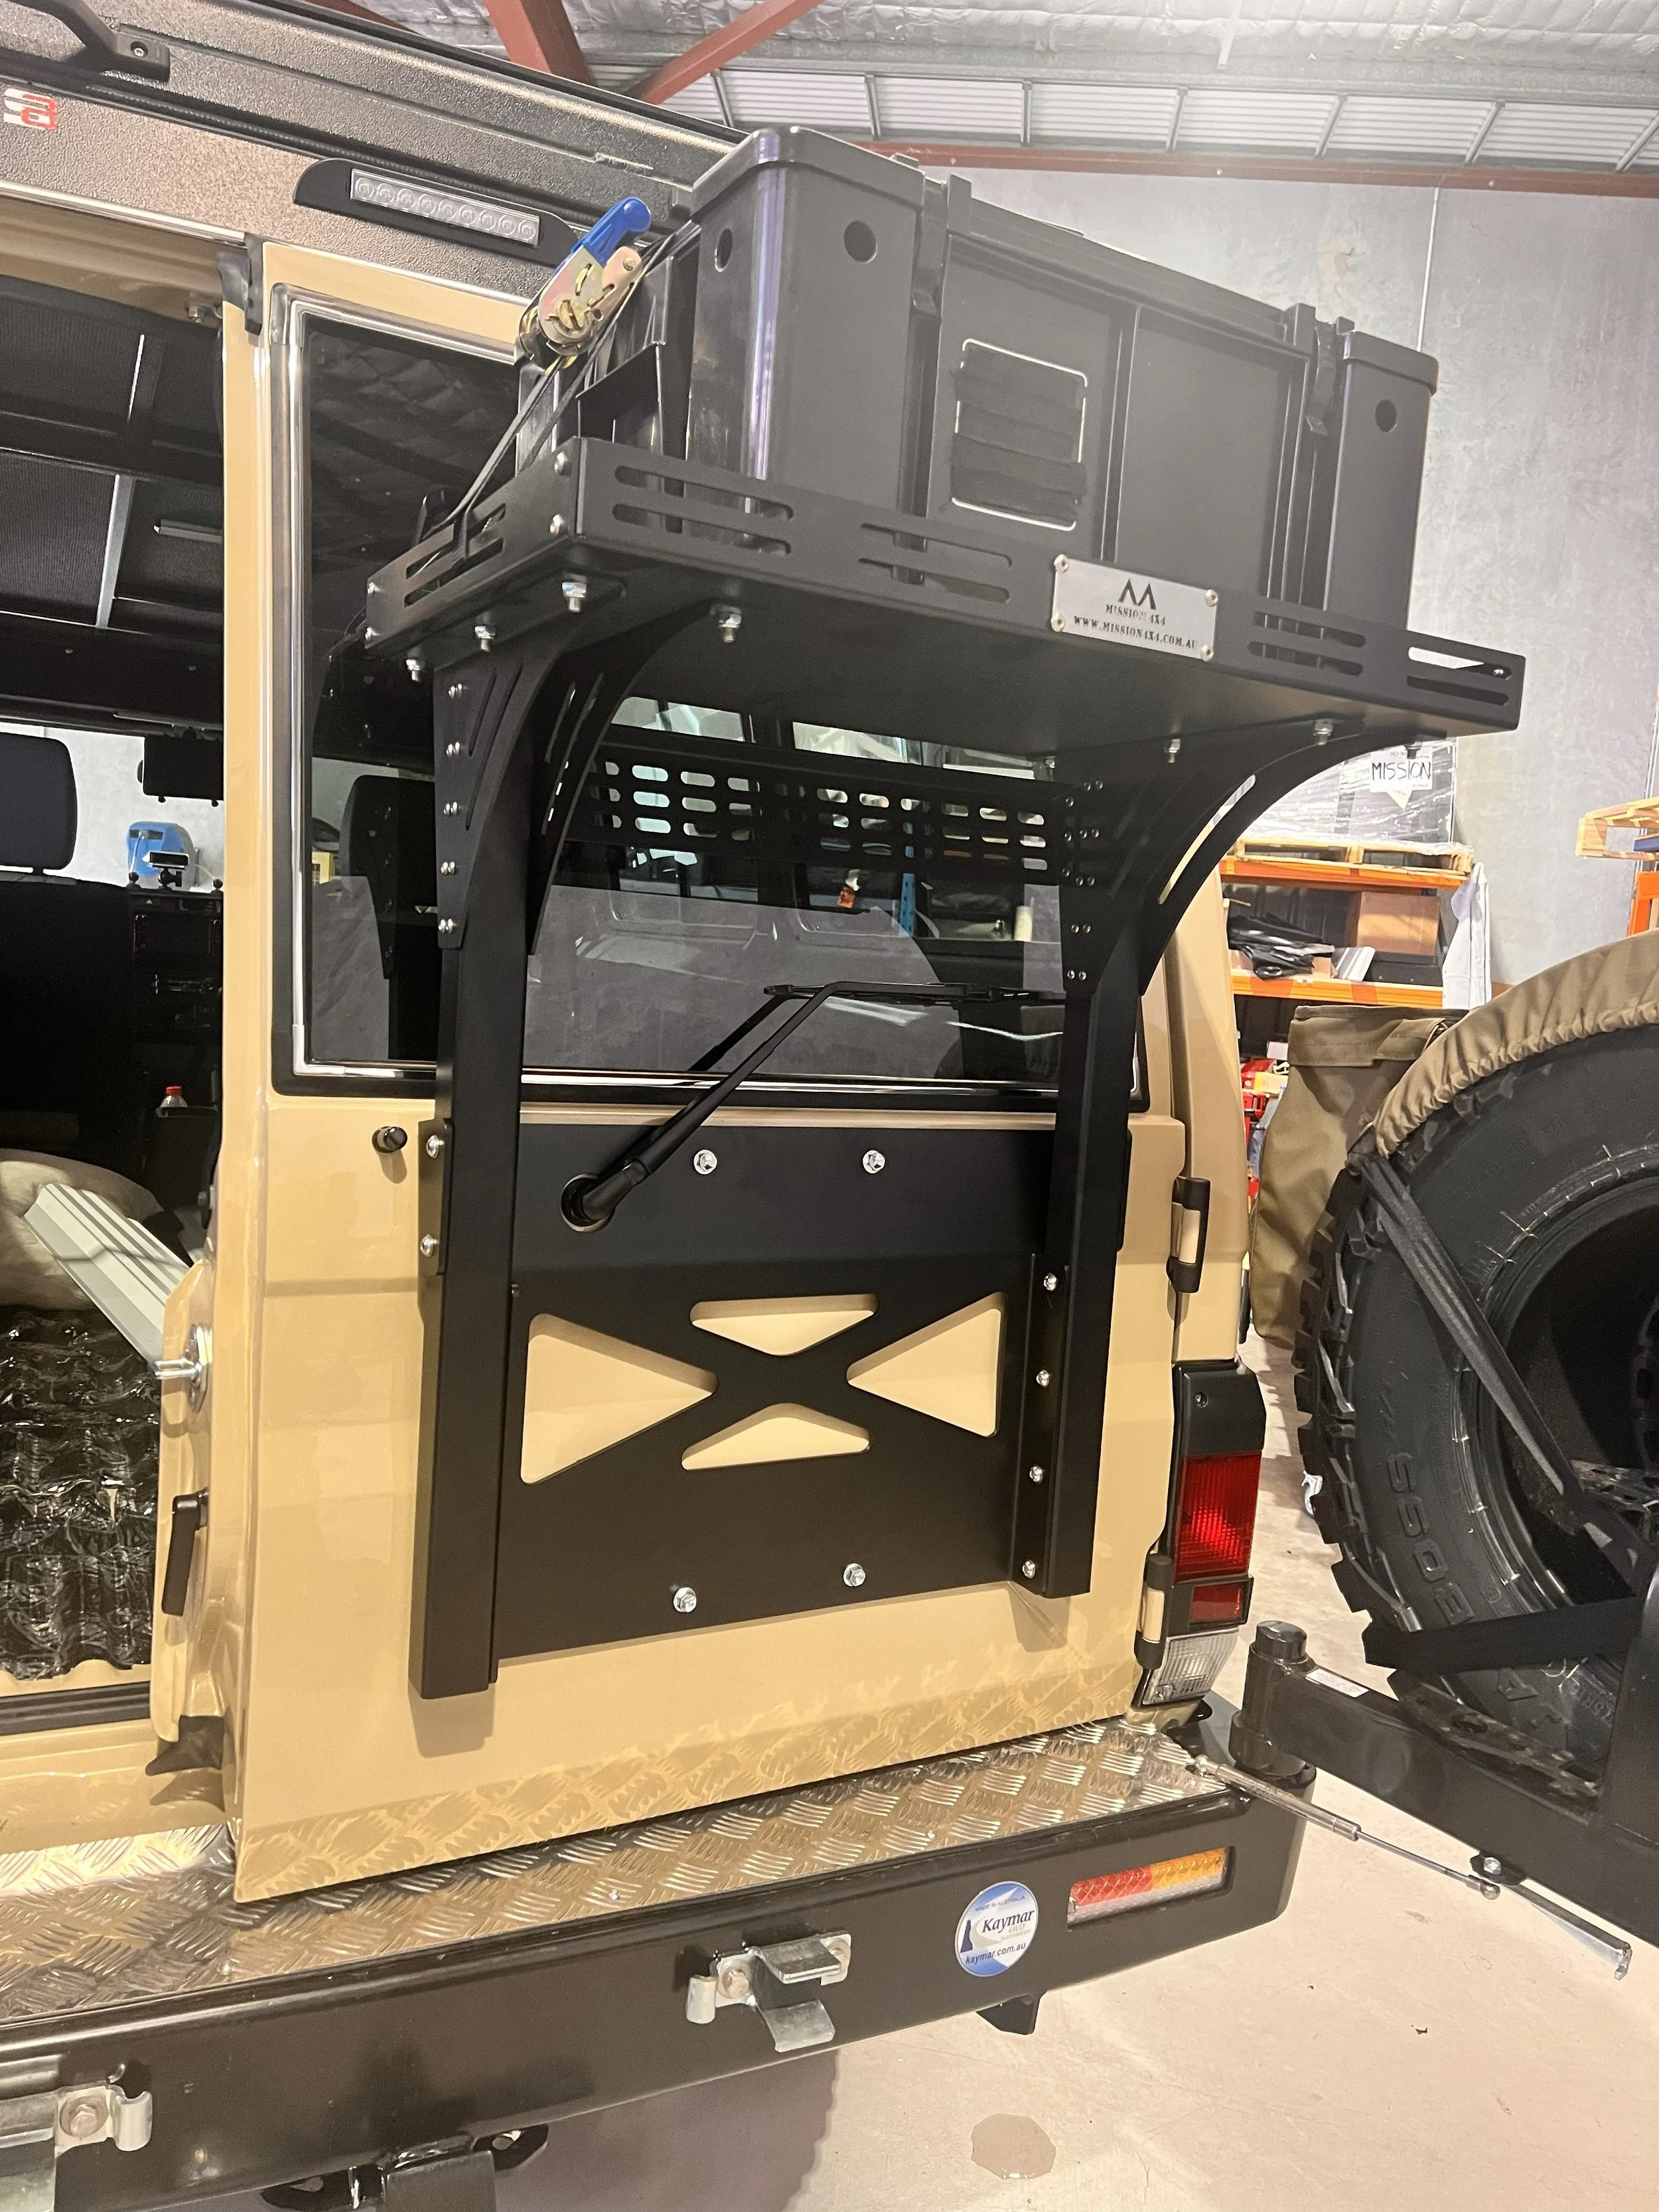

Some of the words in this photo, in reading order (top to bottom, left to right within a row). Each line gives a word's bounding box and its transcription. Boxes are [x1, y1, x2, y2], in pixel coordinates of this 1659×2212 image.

[1073, 615, 1198, 649] WWW.MISSION4X4.COM.AU
[1372, 759, 1431, 781] MISSION
[975, 1903, 990, 1912] MADE
[997, 1895, 1025, 1906] AUSTRALIA
[981, 1909, 1035, 1933] Kaymar
[966, 1942, 1026, 1965] kaymar.com.au
